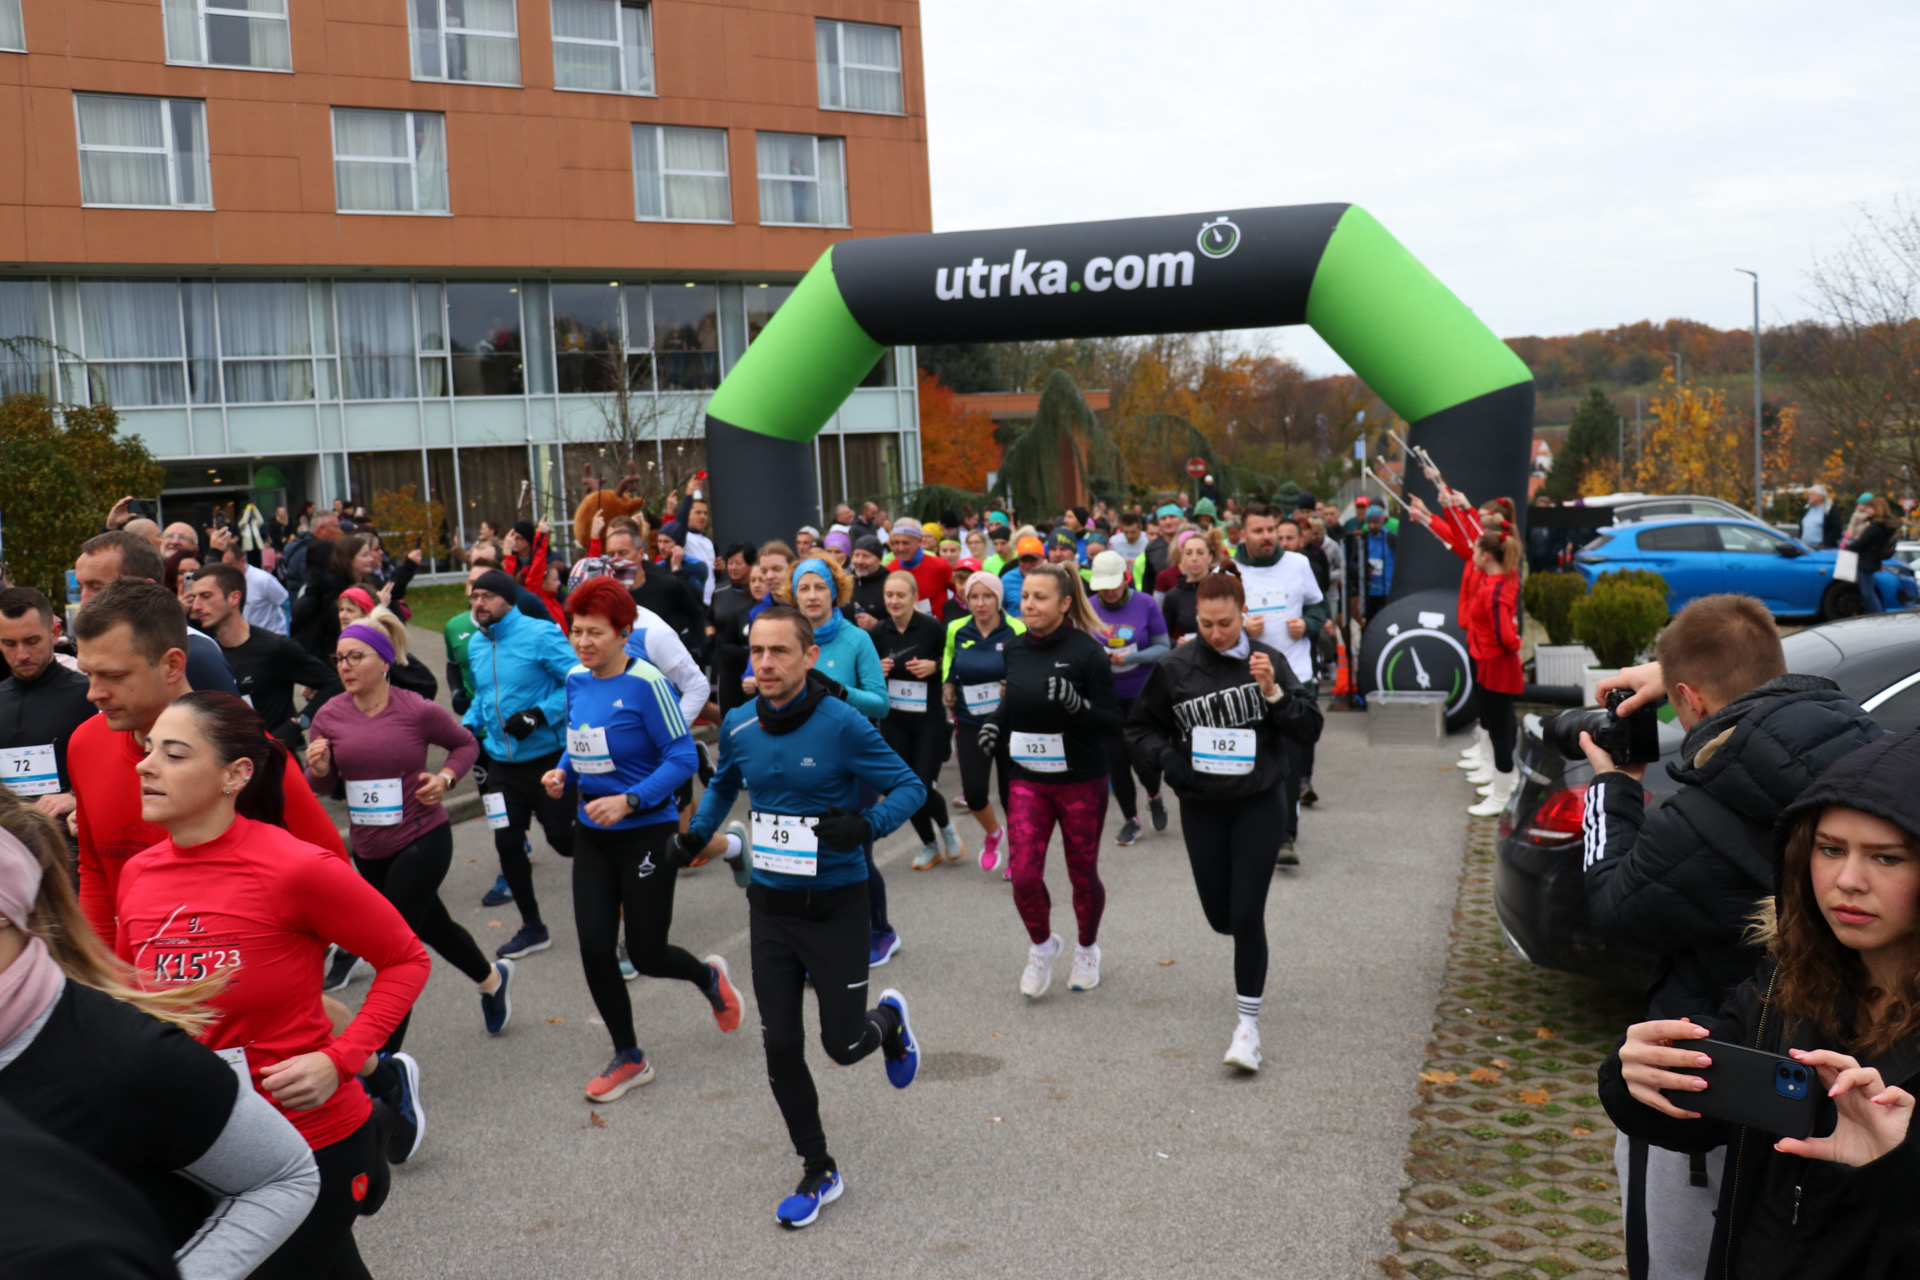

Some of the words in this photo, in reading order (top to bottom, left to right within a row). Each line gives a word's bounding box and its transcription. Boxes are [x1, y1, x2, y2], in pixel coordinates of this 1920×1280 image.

[935, 249, 1195, 301] utrka.com
[900, 688, 912, 697] 65
[573, 741, 591, 752] 201
[1026, 743, 1047, 753] 123
[1211, 739, 1236, 751] 182
[13, 759, 31, 772] 72
[362, 791, 379, 804] 26
[771, 829, 790, 844] 49
[188, 916, 204, 933] 9.
[154, 949, 241, 982] K15'23
